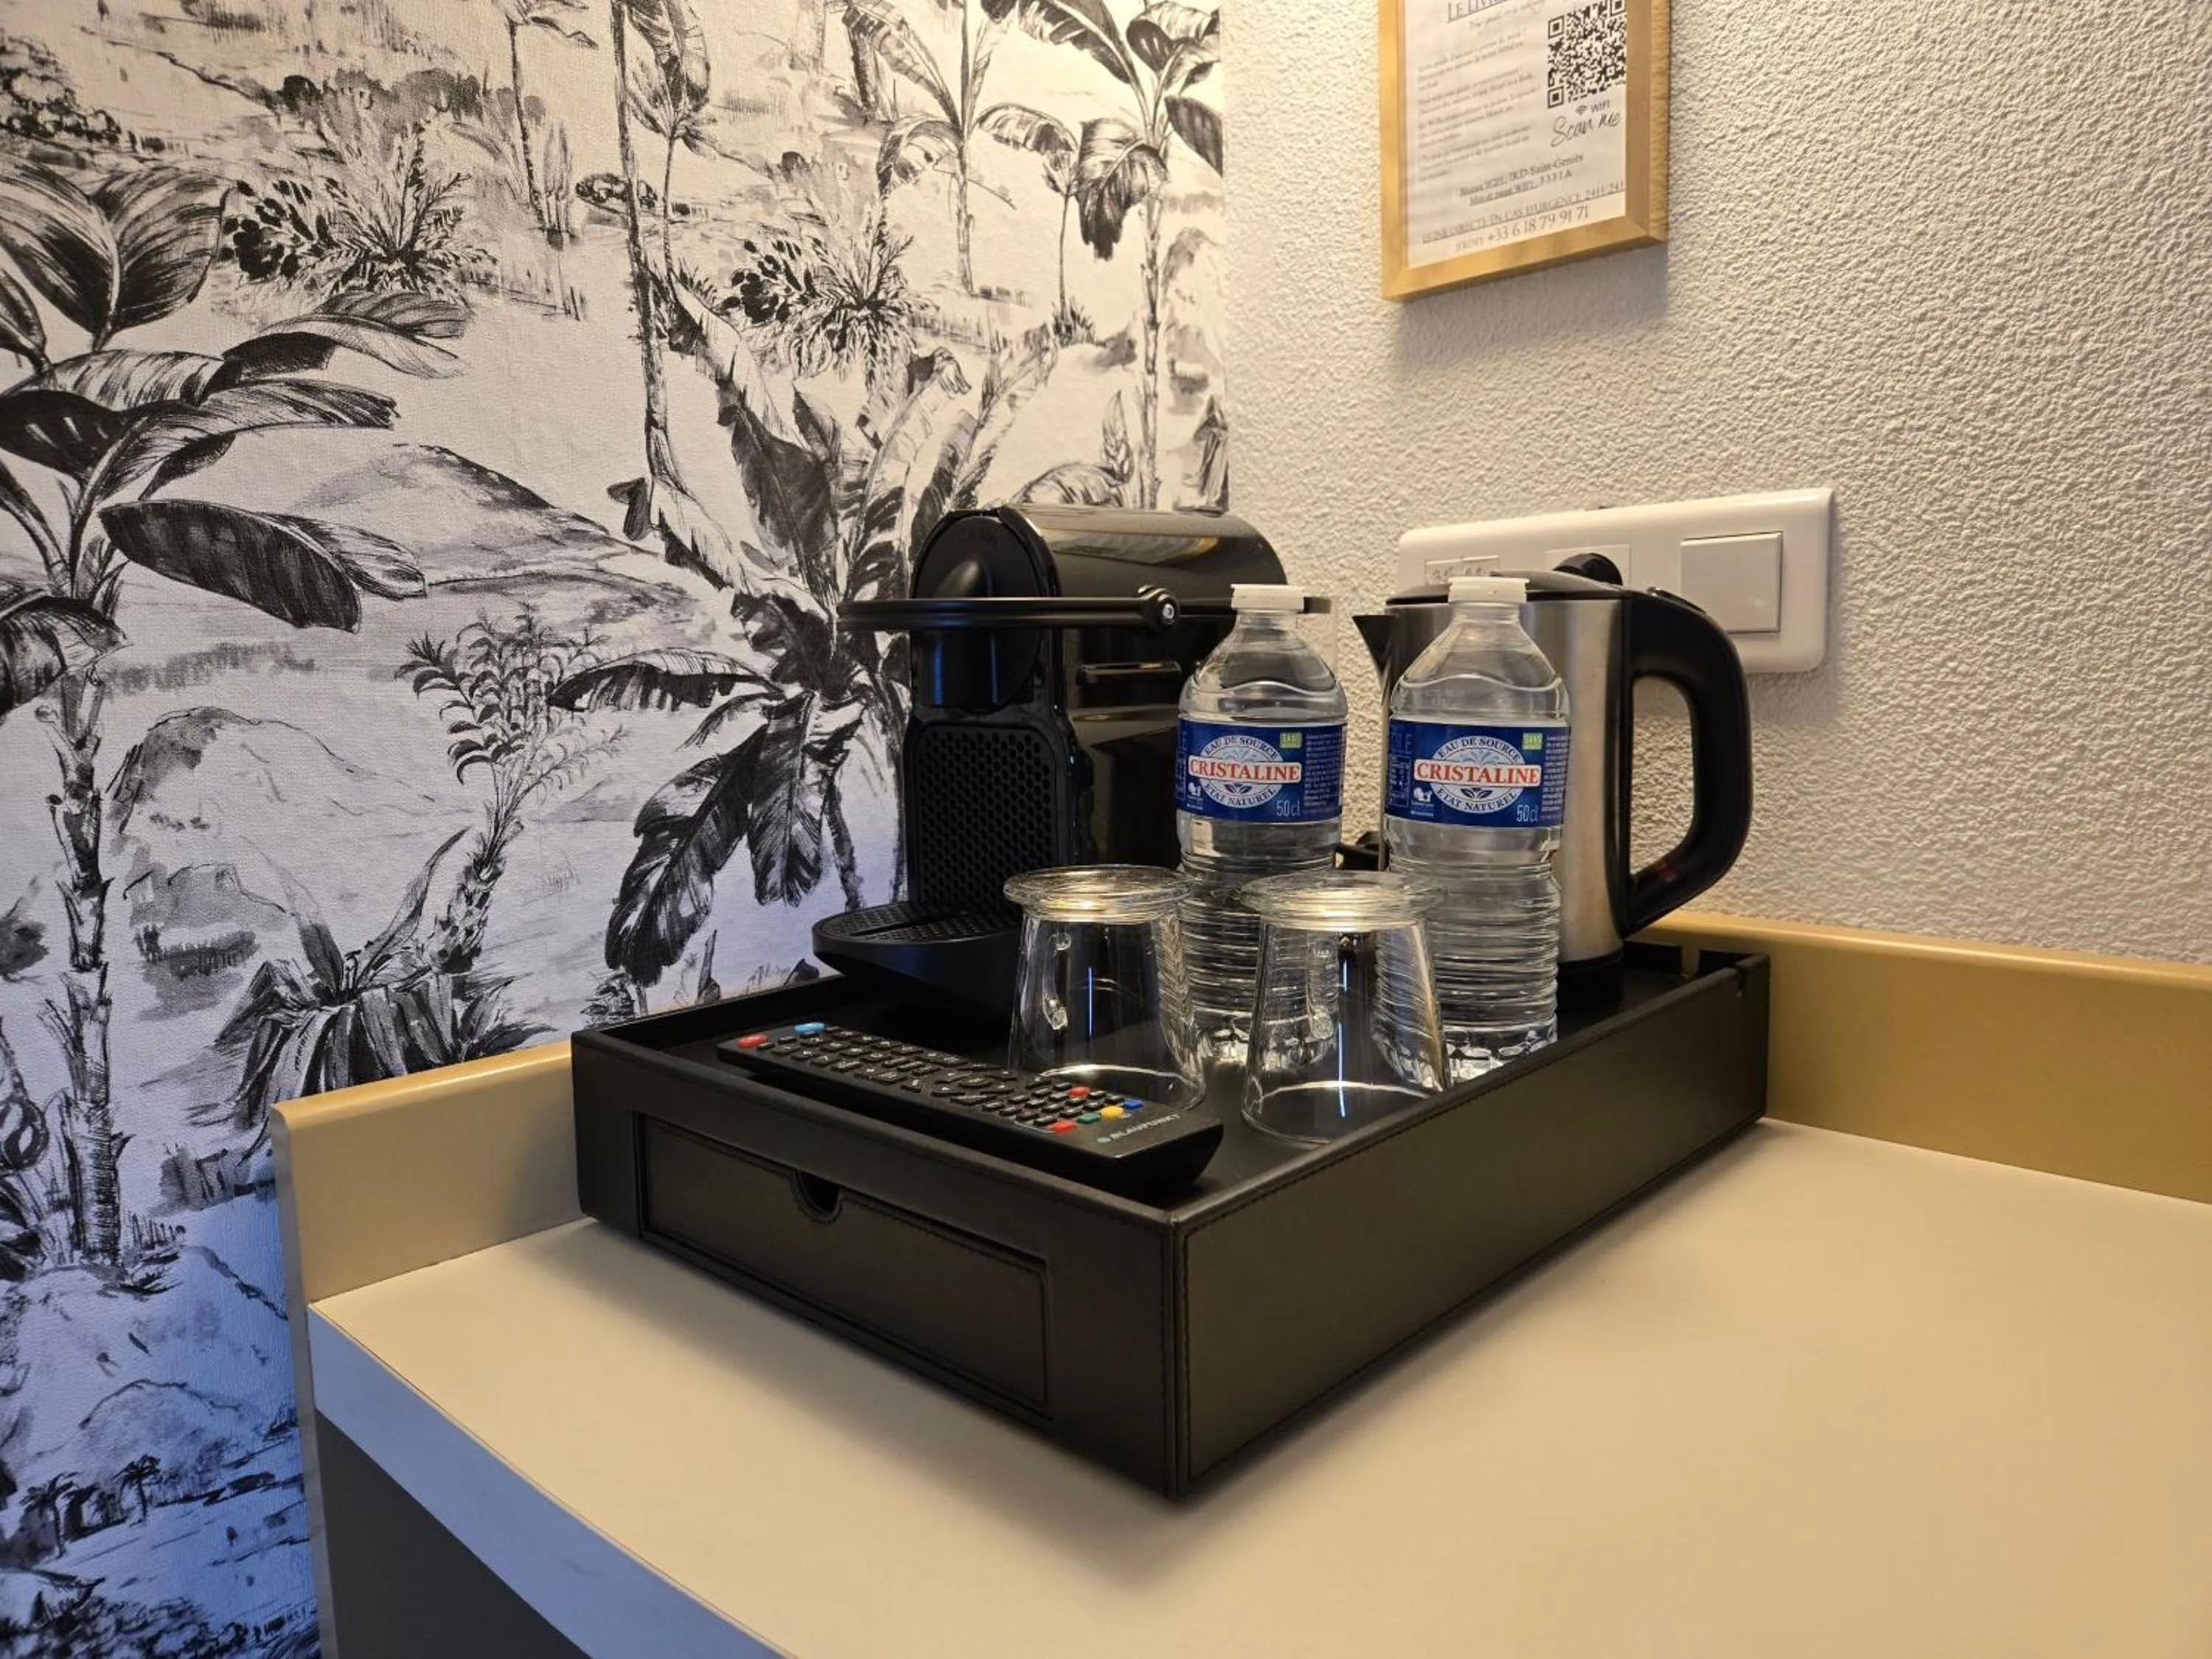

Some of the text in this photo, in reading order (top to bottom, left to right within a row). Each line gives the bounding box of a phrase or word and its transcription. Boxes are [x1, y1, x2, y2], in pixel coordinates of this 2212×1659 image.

[1512, 222, 1520, 237] 6
[1524, 218, 1537, 234] 18
[1539, 213, 1556, 229] 79
[1559, 209, 1572, 223] 91
[1576, 204, 1589, 220] 71
[1205, 740, 1221, 755] EAU
[1225, 736, 1238, 744] DE
[1239, 736, 1279, 760] SOURCE
[1437, 737, 1521, 762] EAU DE SOURCE
[1190, 758, 1300, 781] CRISTALINE
[1416, 762, 1540, 785] CRISTALINE
[1228, 789, 1277, 805] NATUREL
[1436, 788, 1517, 811] ETAT NATUREL
